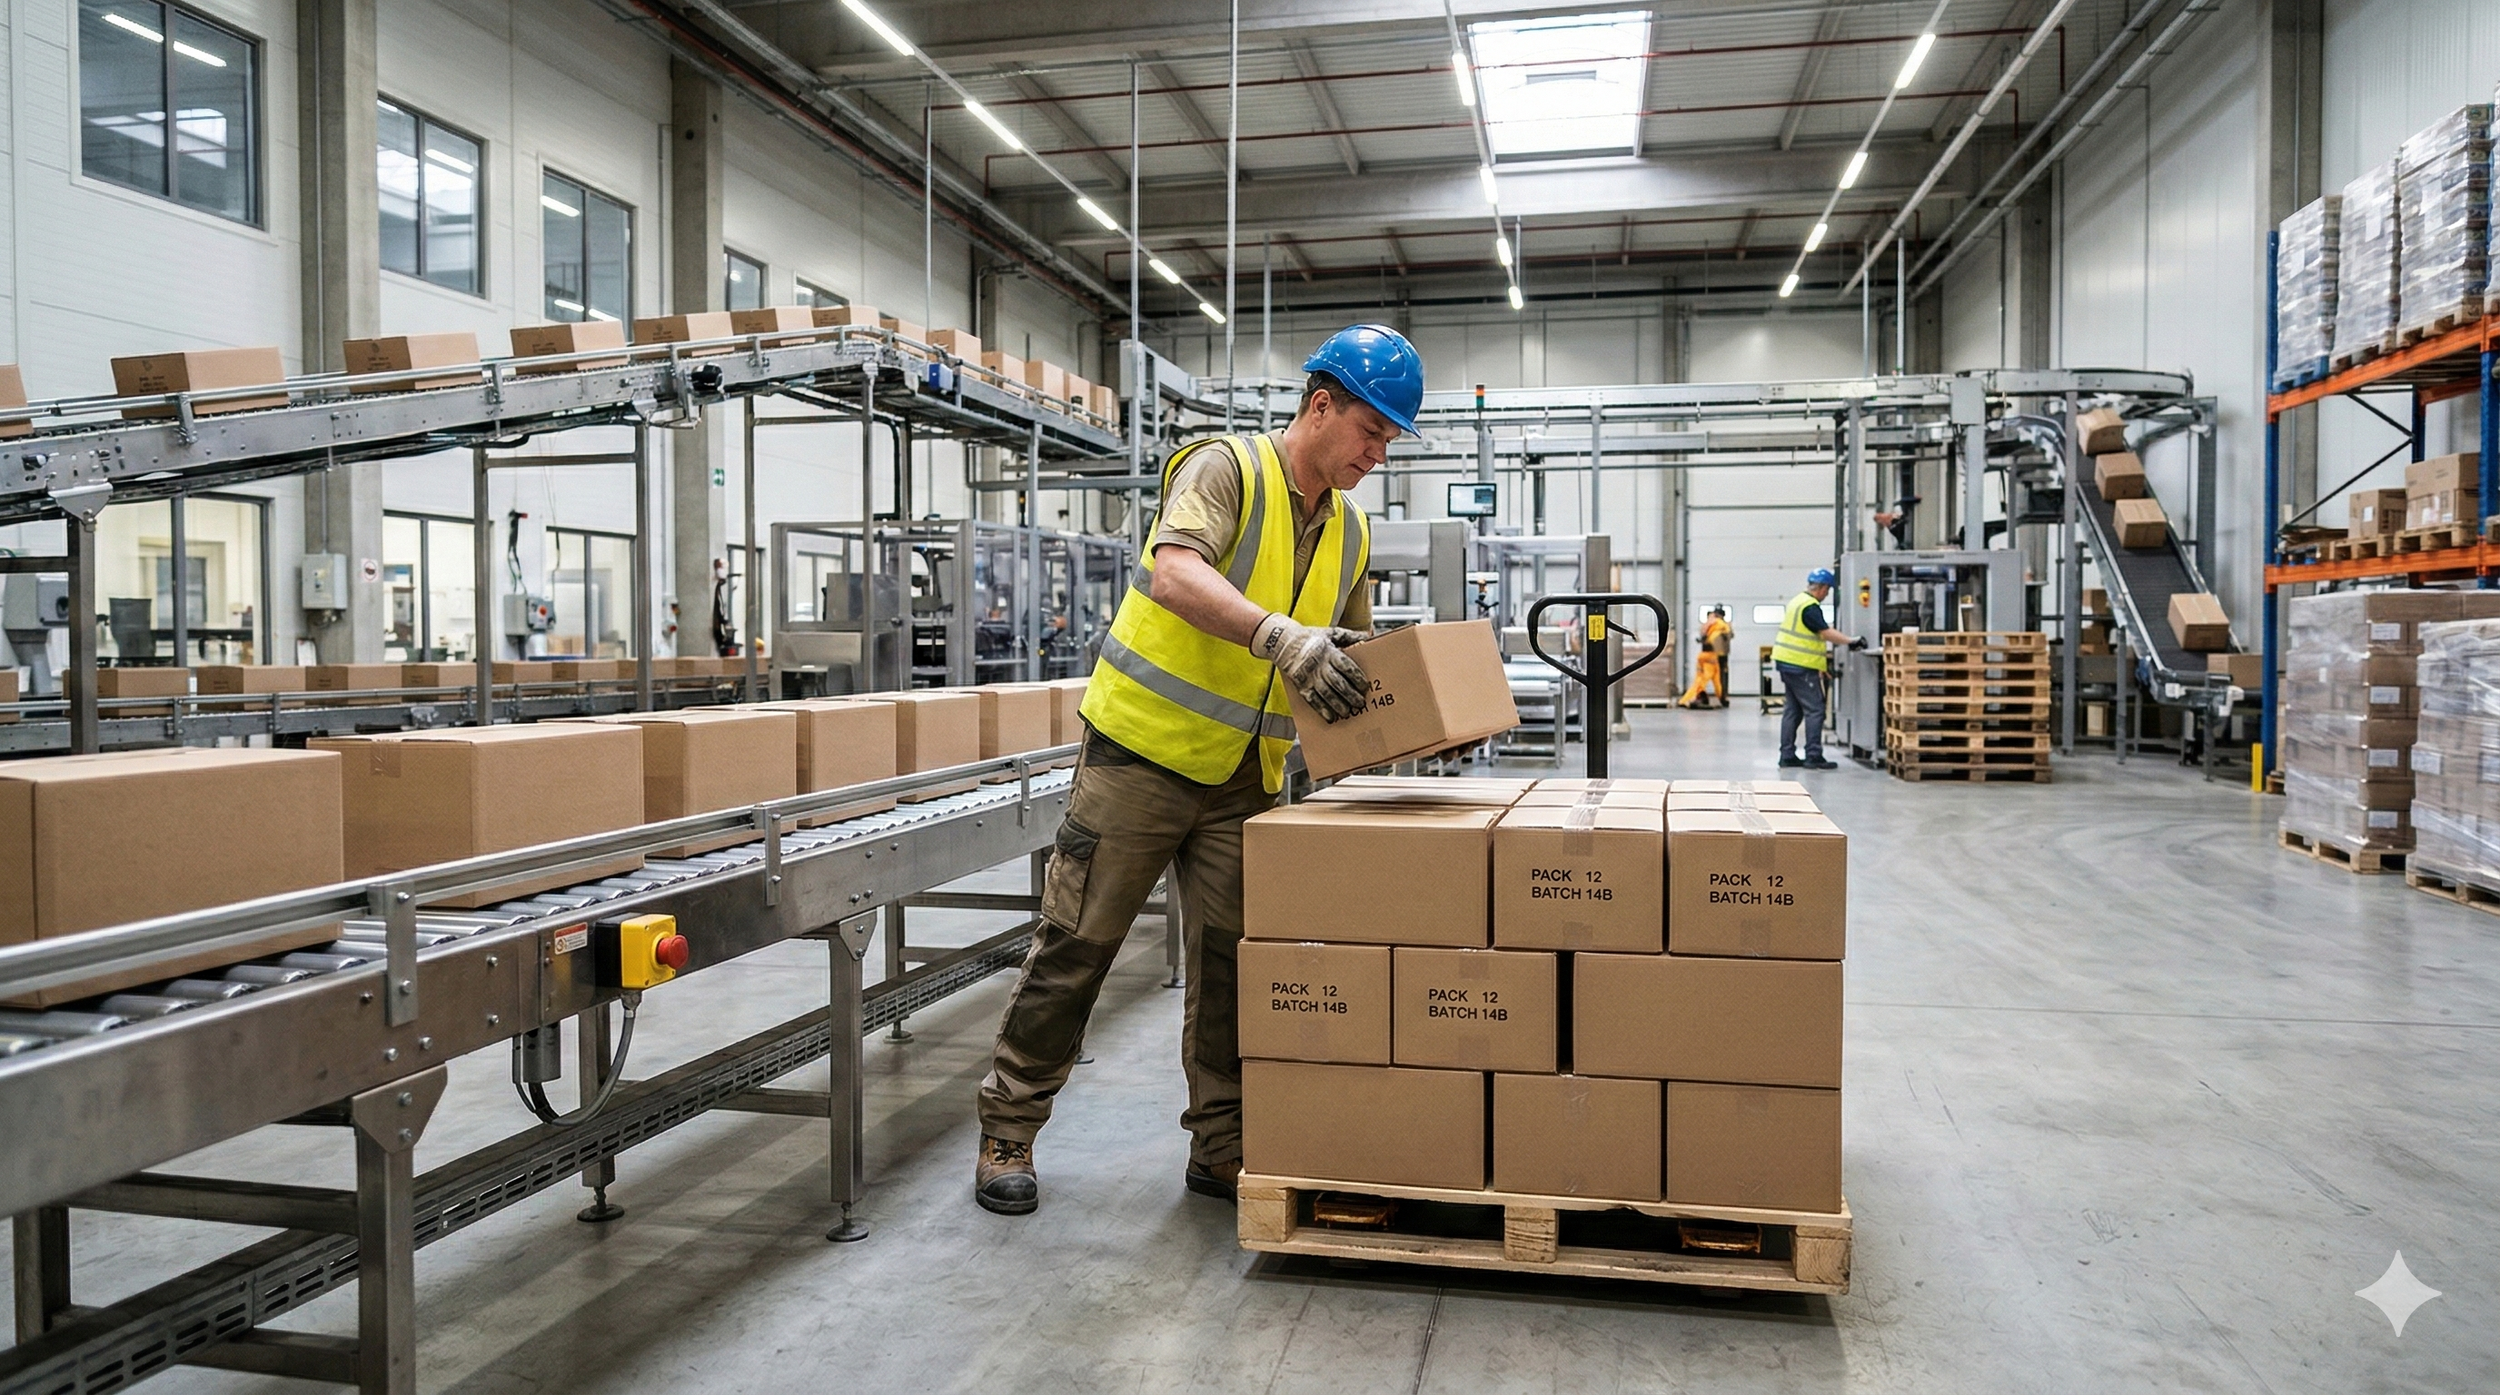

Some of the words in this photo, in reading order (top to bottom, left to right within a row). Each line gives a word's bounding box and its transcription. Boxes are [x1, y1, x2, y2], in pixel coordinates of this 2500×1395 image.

[1371, 693, 1395, 709] 14B
[1531, 868, 1573, 883] PACK
[1585, 870, 1602, 883] 12
[1709, 873, 1752, 887] PACK
[1766, 875, 1784, 888] 12
[1531, 886, 1582, 900] BATCH
[1585, 888, 1613, 901] 14B
[1709, 890, 1762, 905] BATCH
[1766, 892, 1795, 906] 14B
[1271, 982, 1310, 996] PACK
[1322, 984, 1338, 997] 12
[1428, 988, 1469, 1003] PACK
[1482, 991, 1499, 1004] 12
[1271, 998, 1319, 1013] BATCH
[1322, 1001, 1348, 1014] 14B
[1428, 1005, 1478, 1020] BATCH
[1481, 1007, 1509, 1021] 14B
